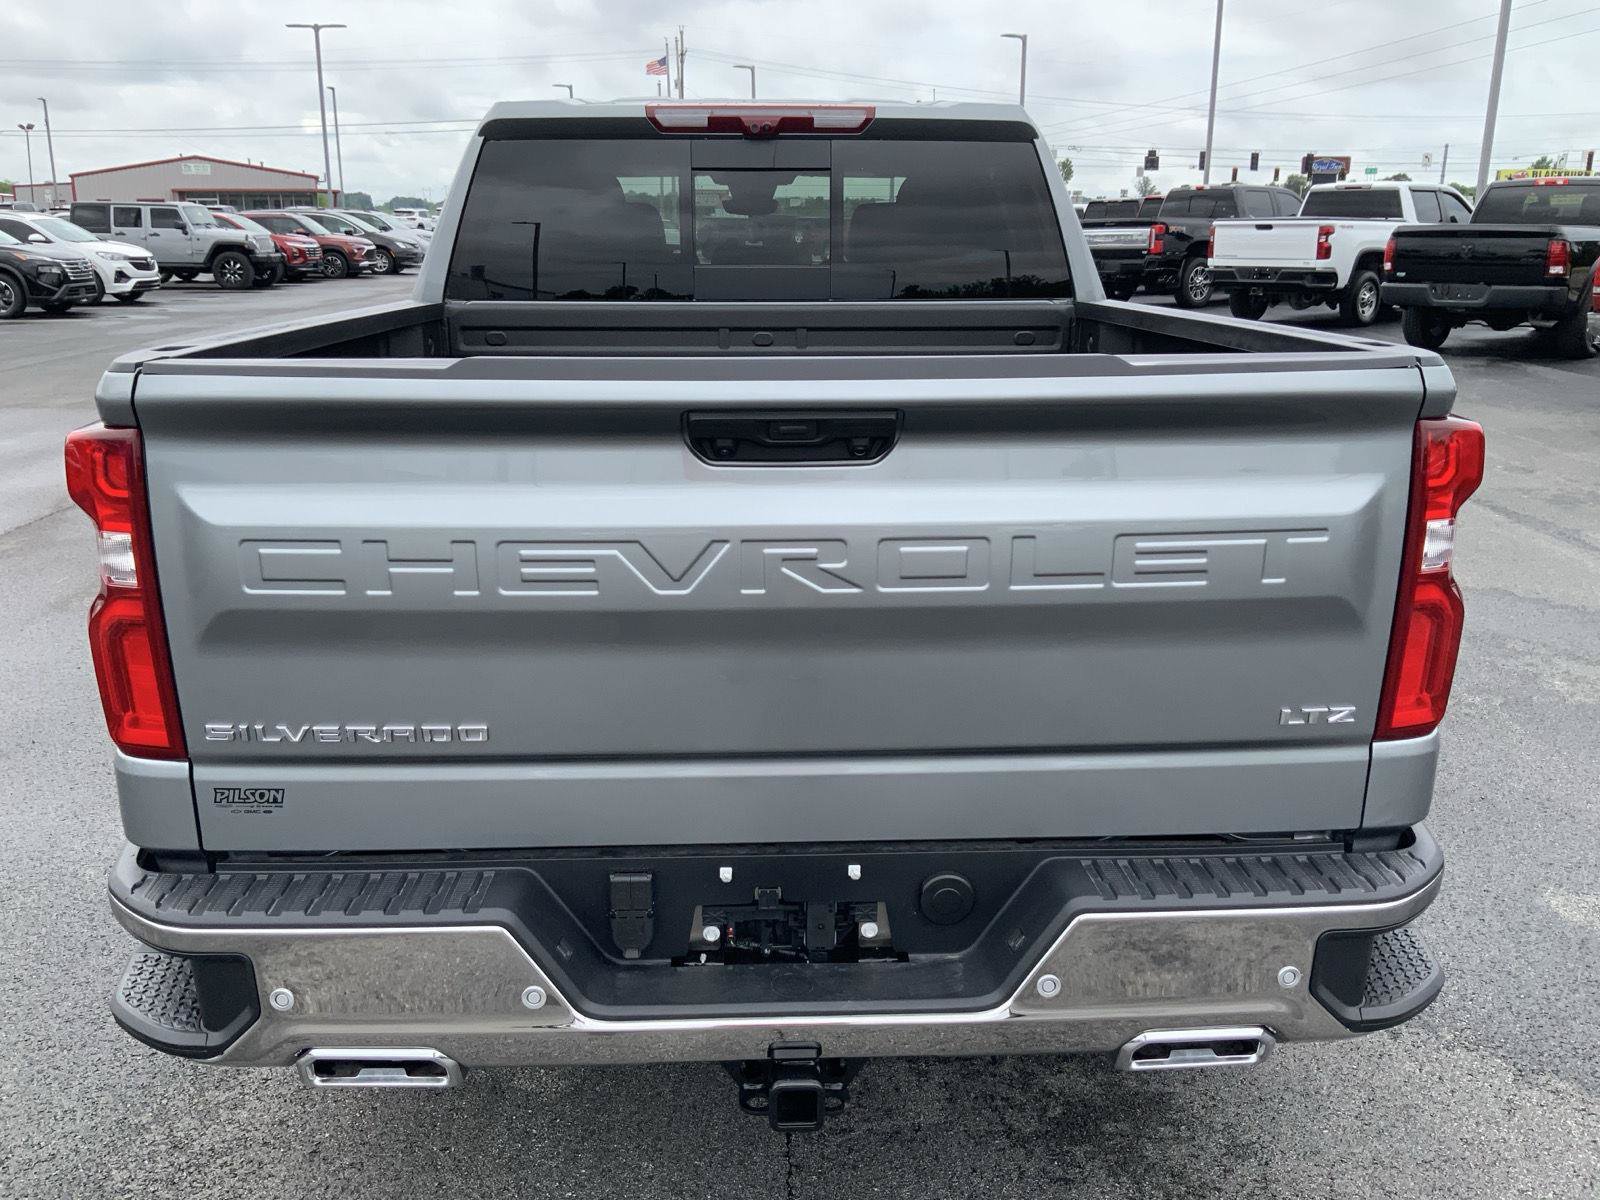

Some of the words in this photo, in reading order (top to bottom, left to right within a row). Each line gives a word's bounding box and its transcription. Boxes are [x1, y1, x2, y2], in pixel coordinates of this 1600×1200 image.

[239, 528, 1330, 597] CHEVROLET
[1279, 705, 1356, 726] LTZ
[204, 723, 490, 743] SILVERADO
[213, 788, 285, 804] PILSON
